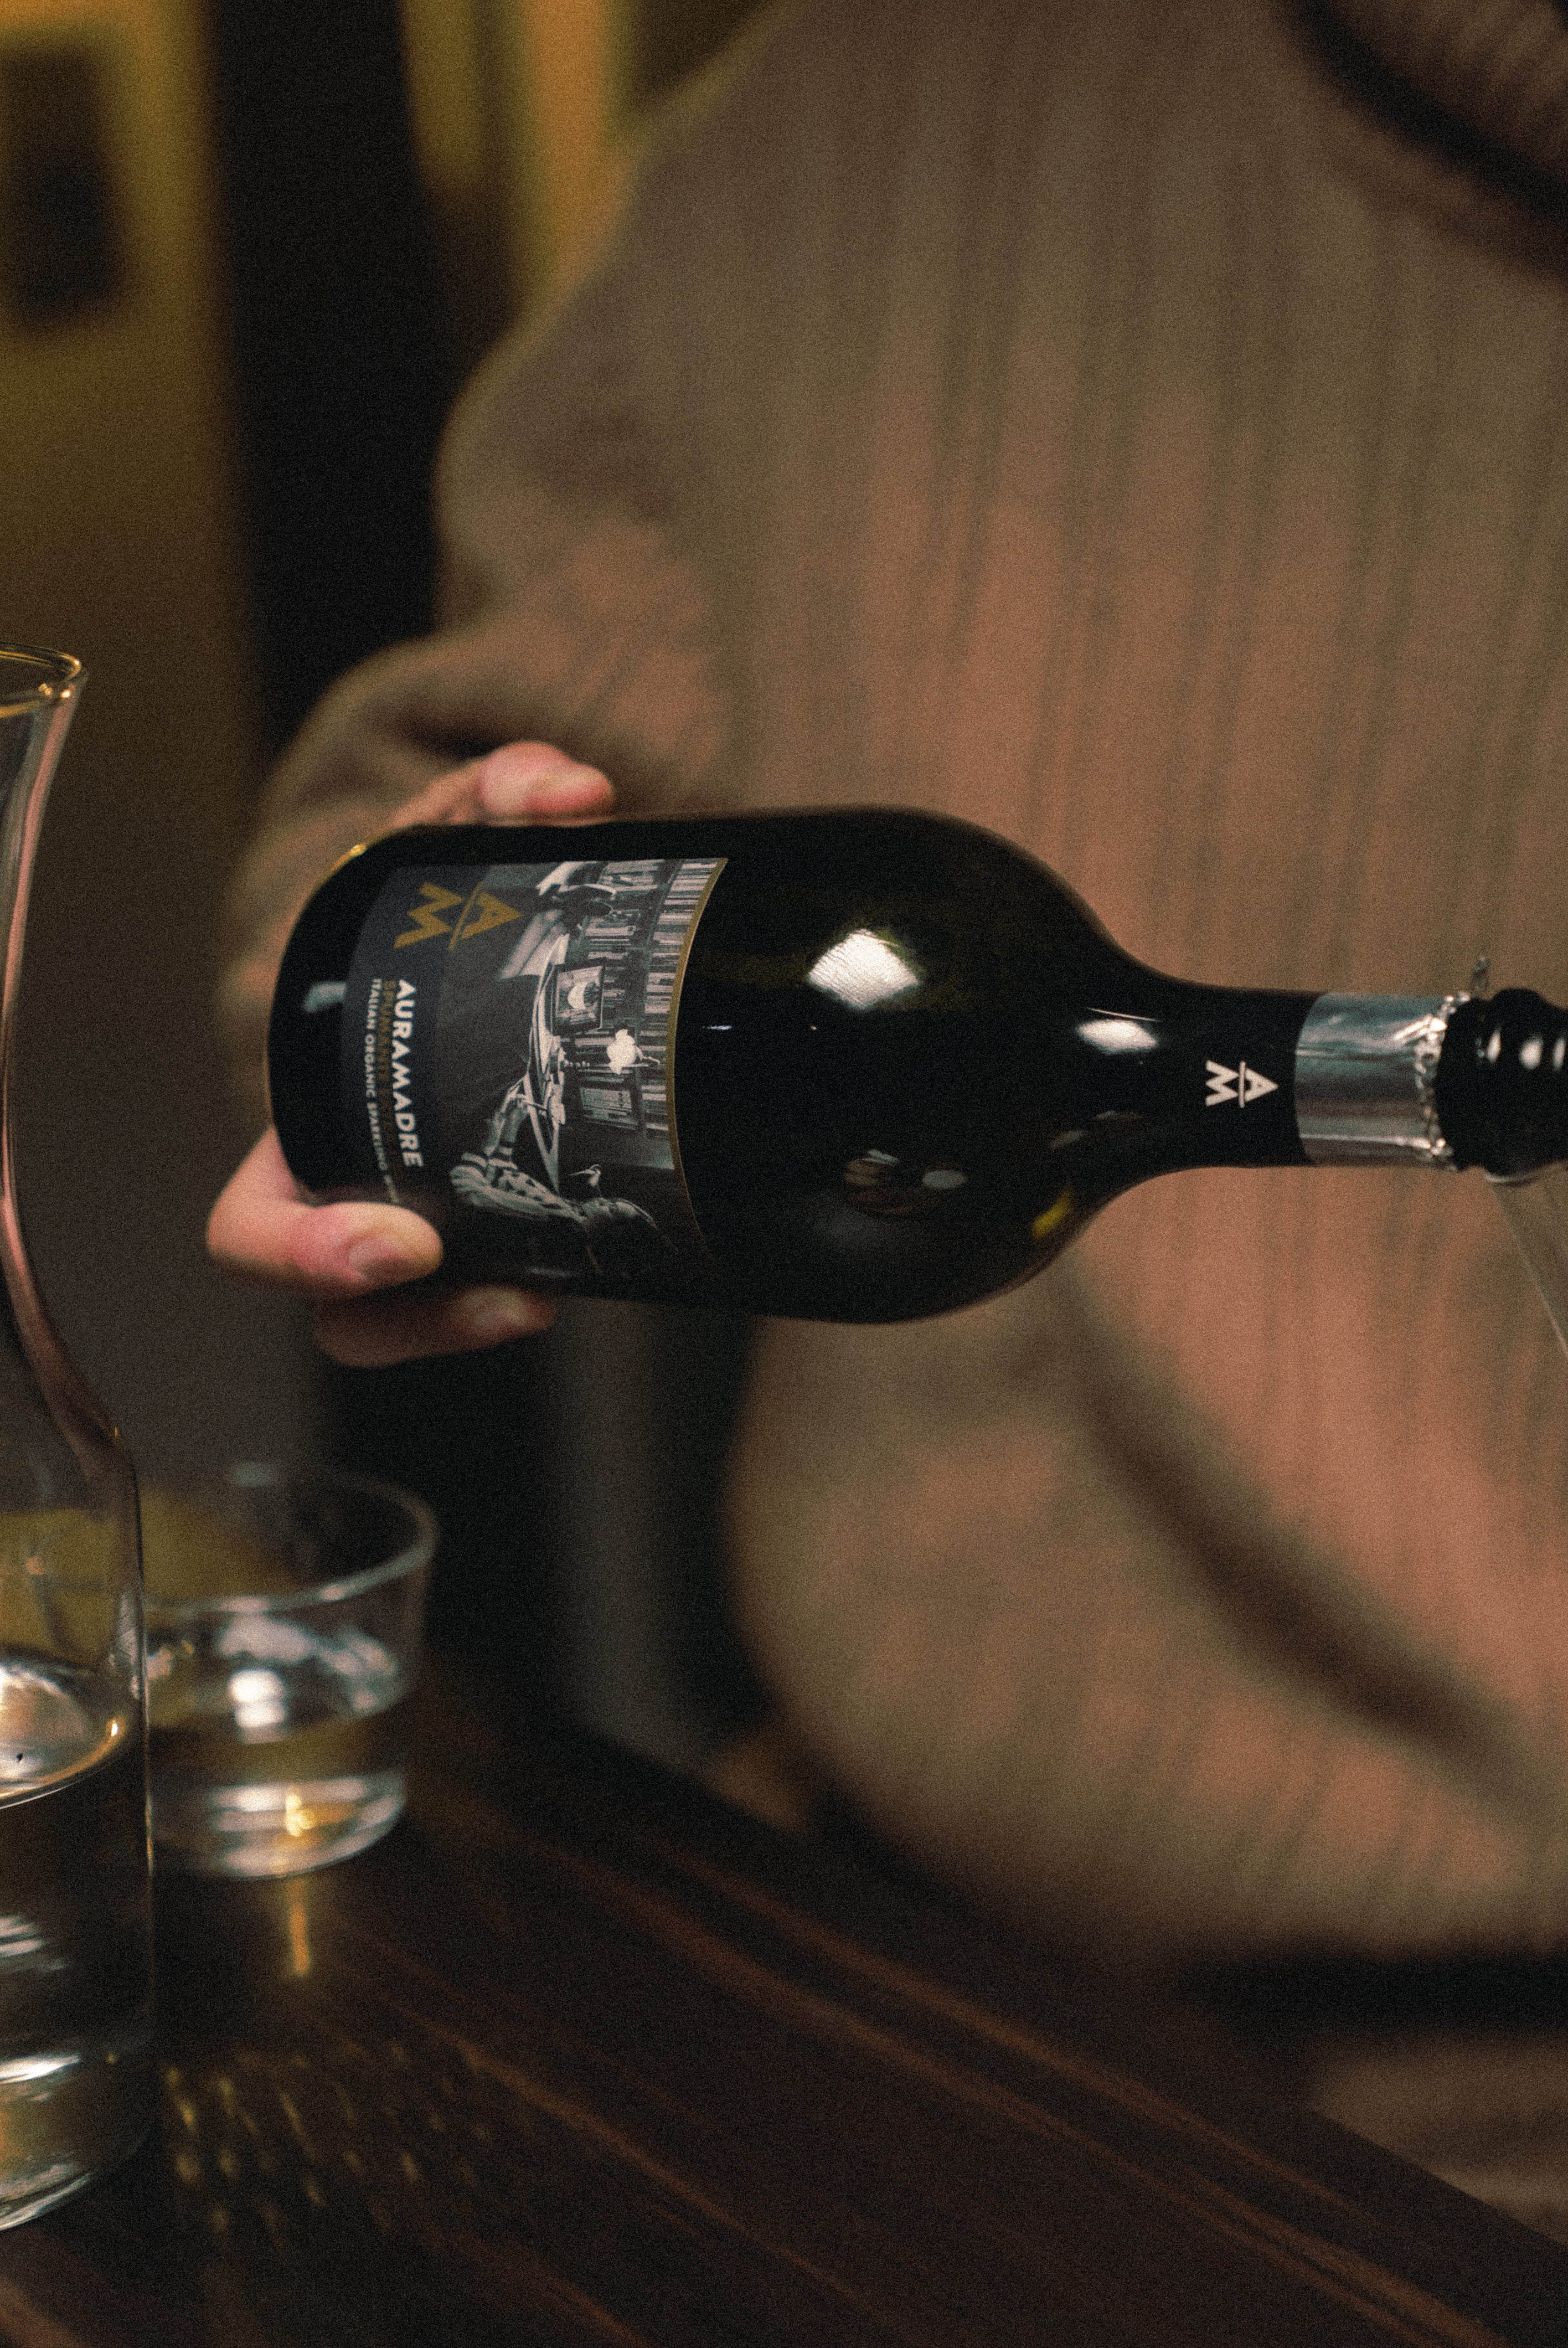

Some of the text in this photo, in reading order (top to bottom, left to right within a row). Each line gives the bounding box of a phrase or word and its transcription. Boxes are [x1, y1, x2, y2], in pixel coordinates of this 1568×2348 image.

[364, 978, 388, 1171] ITALIAN ORGANIC SPARKLING
[391, 979, 422, 1167] AURAMADRE
